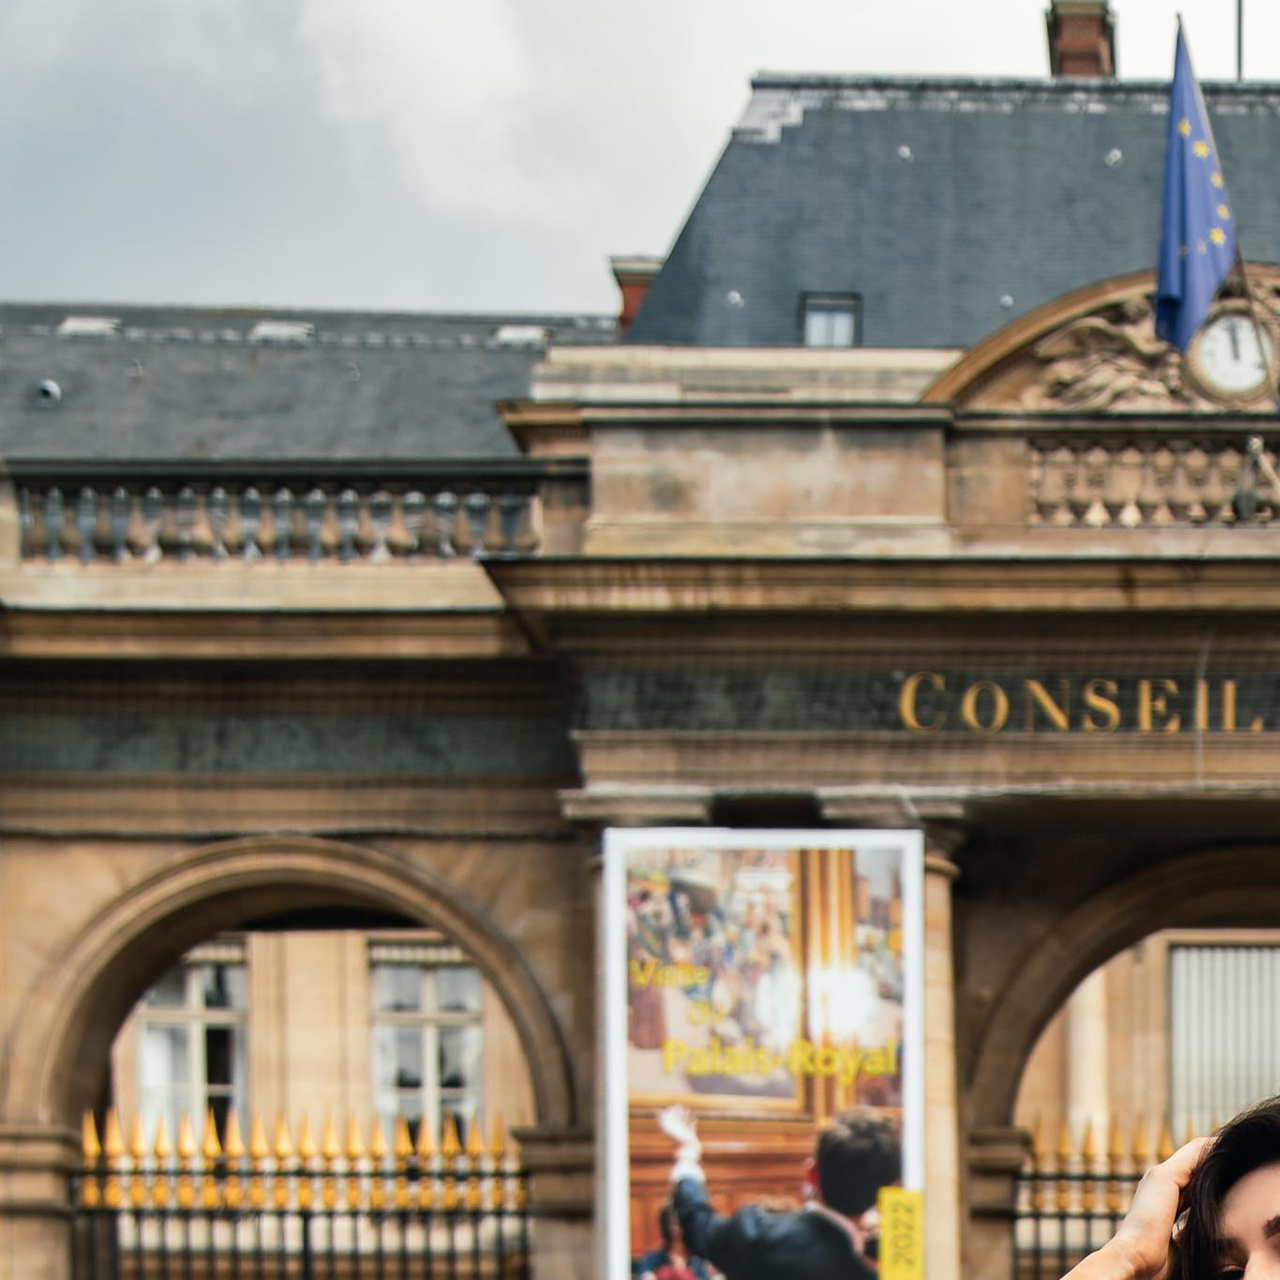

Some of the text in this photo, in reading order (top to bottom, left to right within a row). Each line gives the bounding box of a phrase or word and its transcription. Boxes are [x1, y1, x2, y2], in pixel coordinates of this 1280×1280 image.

[899, 671, 1265, 735] CONSEIL
[661, 1035, 898, 1088] Palais-Royal
[890, 1200, 915, 1267] 2022
